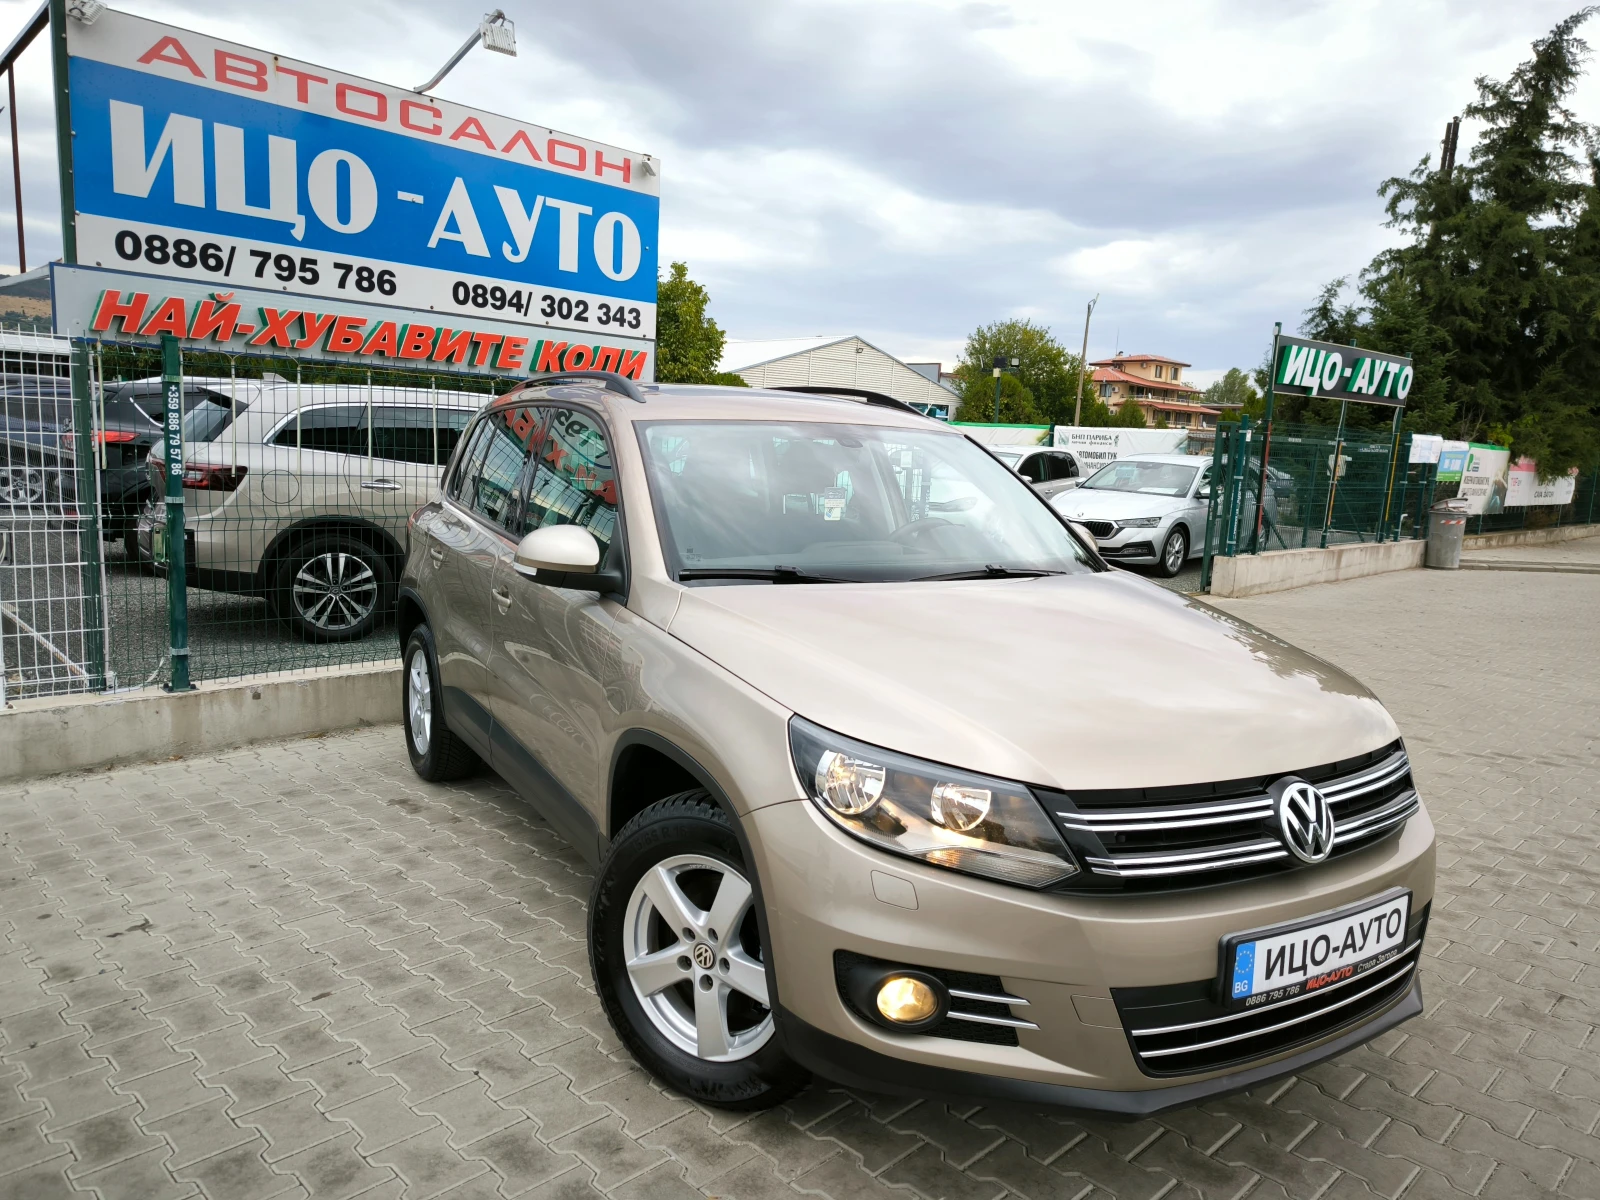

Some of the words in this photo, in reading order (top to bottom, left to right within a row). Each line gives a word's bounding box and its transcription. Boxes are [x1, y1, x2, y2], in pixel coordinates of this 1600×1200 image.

[137, 35, 631, 184] АВТОСАЛОН
[114, 230, 236, 277] 0886/
[249, 249, 320, 286] 795
[333, 262, 398, 296] 786
[452, 281, 533, 317] 0894/
[540, 294, 589, 322] 302
[597, 303, 641, 330] 343
[91, 289, 529, 369] НАЙ-ХУБАВИТЕ
[532, 339, 648, 380] КОЛИ
[168, 385, 180, 409] +359
[168, 412, 180, 431] 886
[169, 433, 181, 446] 79
[170, 448, 182, 460] 57
[1076, 450, 1107, 460] ВТОМОБИЛ
[171, 463, 183, 476] 86
[1264, 907, 1402, 981] ИЦО-АУТО
[1234, 980, 1249, 993] BG
[1245, 994, 1267, 1006] 0886
[1268, 989, 1284, 1000] 795
[1285, 985, 1300, 996] 786
[1305, 966, 1354, 991] ИЦО-АУТО
